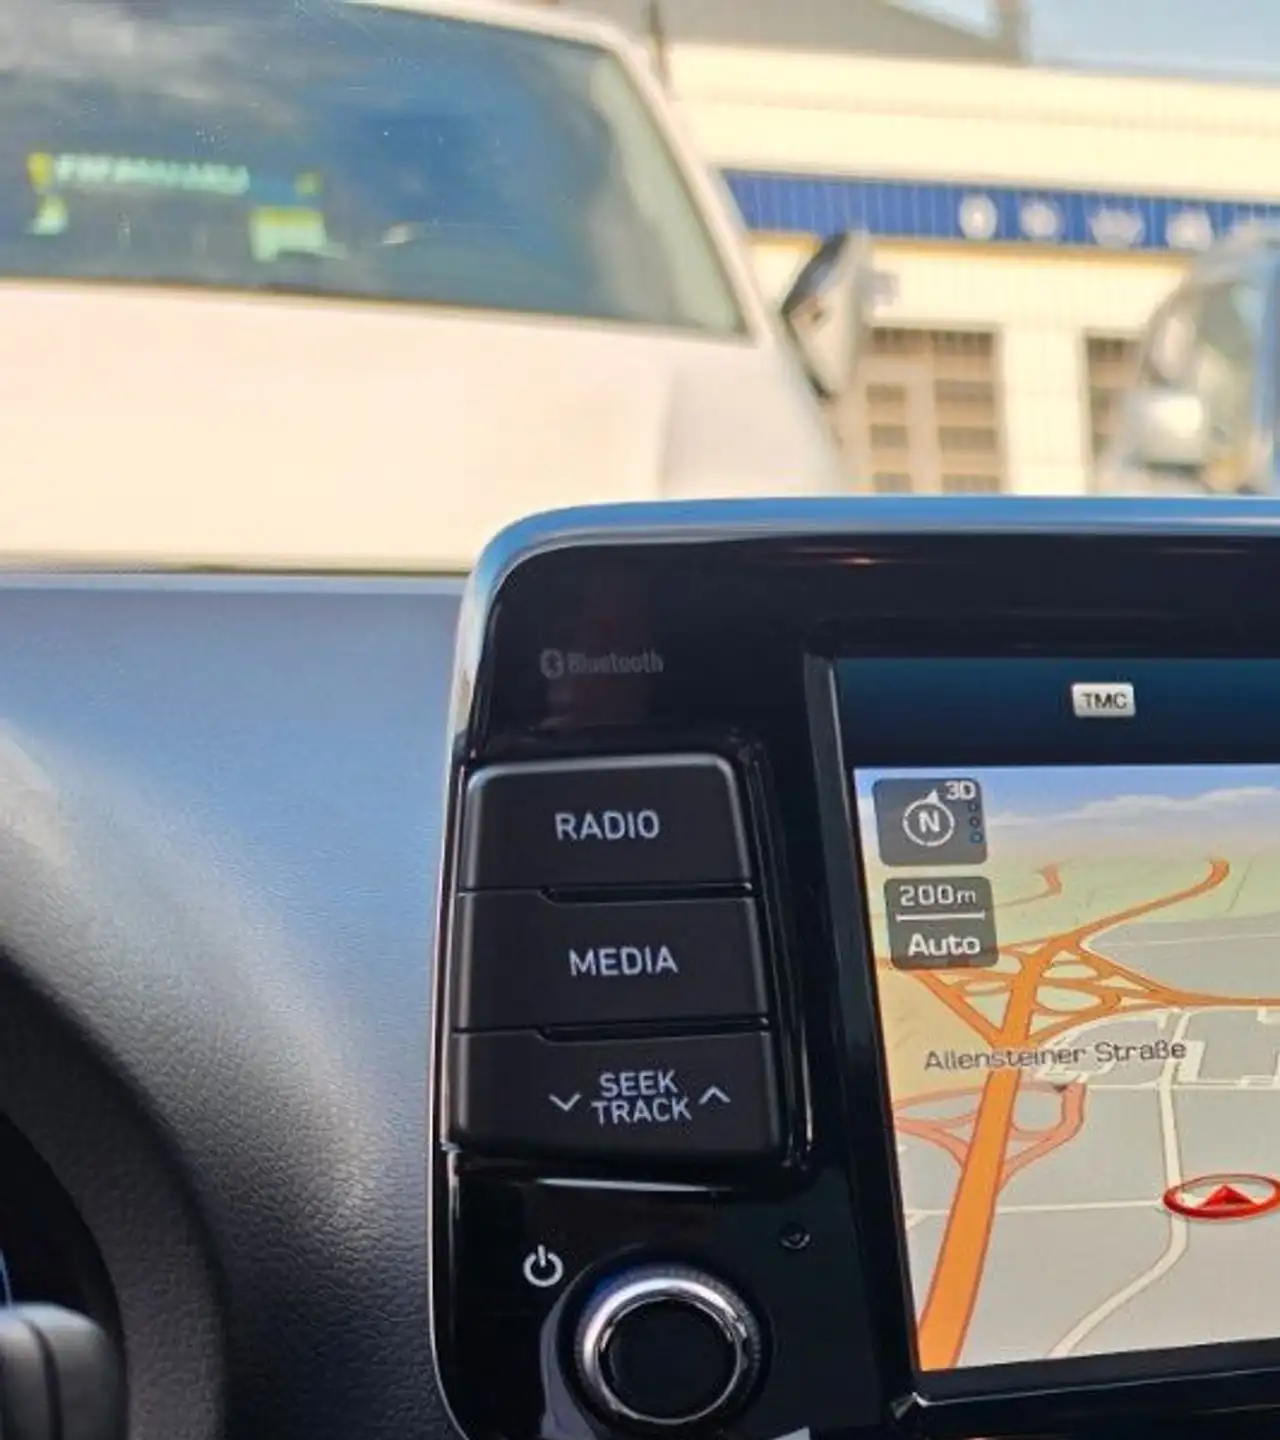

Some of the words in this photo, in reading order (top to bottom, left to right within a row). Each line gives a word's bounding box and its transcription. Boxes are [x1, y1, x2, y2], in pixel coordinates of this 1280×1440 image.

[567, 648, 664, 674] Bluetooth
[1083, 692, 1128, 711] TMC
[945, 780, 977, 800] 3D
[554, 808, 660, 842] RADIO
[918, 811, 940, 833] N
[899, 884, 977, 907] 200m
[908, 931, 981, 957] Auto
[569, 945, 678, 977] MEDIA
[924, 1044, 1088, 1071] Allensteiner
[1095, 1039, 1188, 1063] Straße
[599, 1069, 678, 1099] SEEK
[591, 1097, 692, 1126] TRACK
